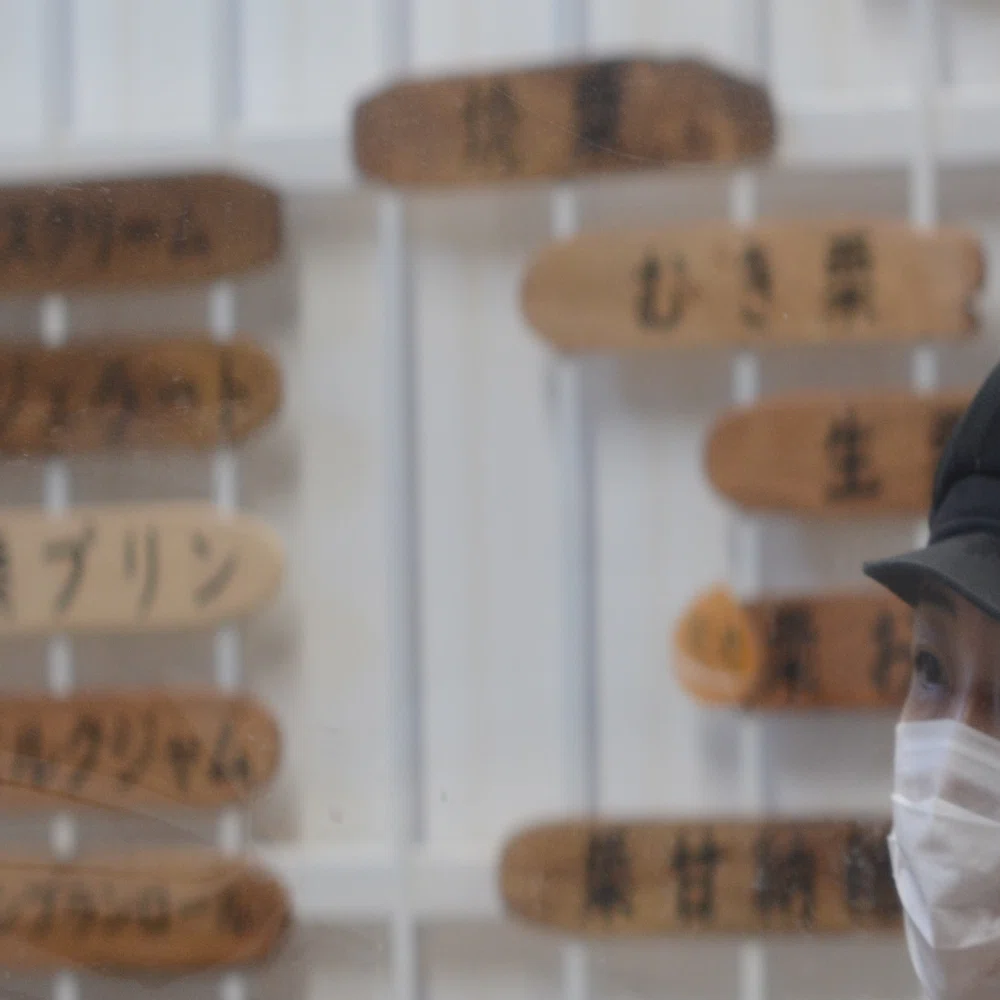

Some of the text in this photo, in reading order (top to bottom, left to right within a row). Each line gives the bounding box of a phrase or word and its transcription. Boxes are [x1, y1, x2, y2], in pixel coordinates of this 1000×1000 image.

[632, 229, 878, 330] むき栗
[0, 525, 238, 622] プリン
